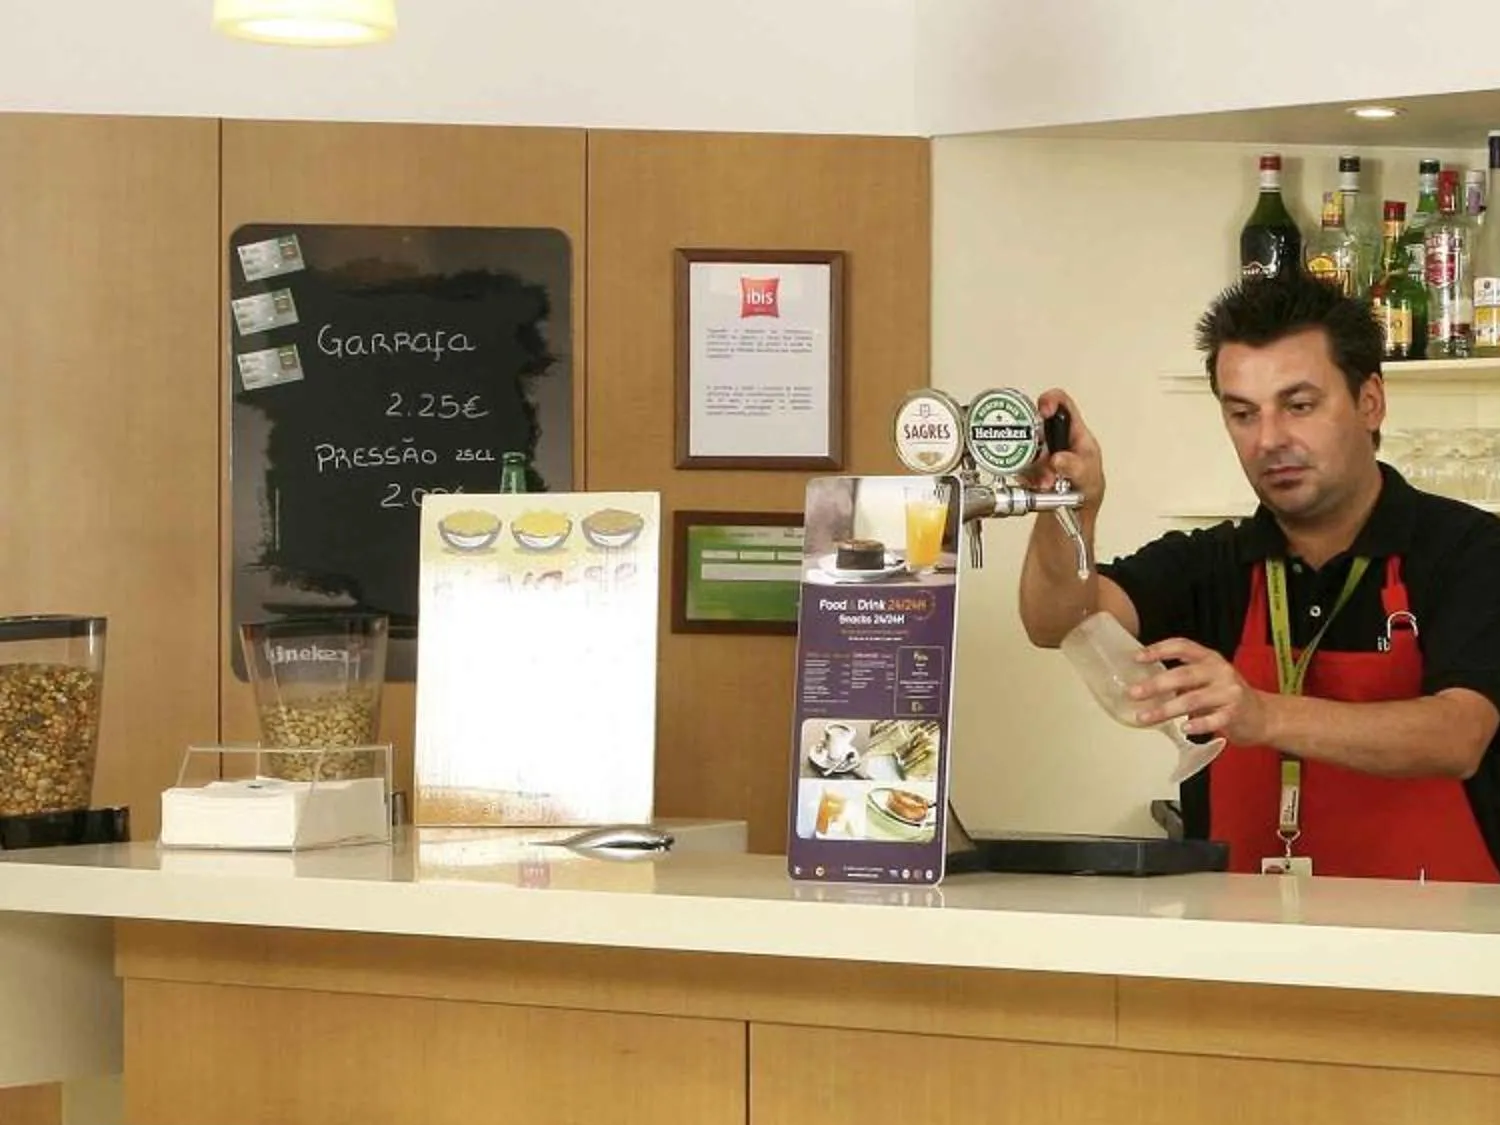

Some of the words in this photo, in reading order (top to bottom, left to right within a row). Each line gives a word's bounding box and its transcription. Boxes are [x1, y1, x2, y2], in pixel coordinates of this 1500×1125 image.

[747, 287, 774, 305] ibis
[385, 392, 490, 419] 2.25€
[904, 423, 951, 440] SAGRES
[975, 427, 1027, 440] Heineken
[315, 437, 437, 473] PRESSÃO
[819, 599, 847, 611] Food
[857, 599, 886, 611] Drink
